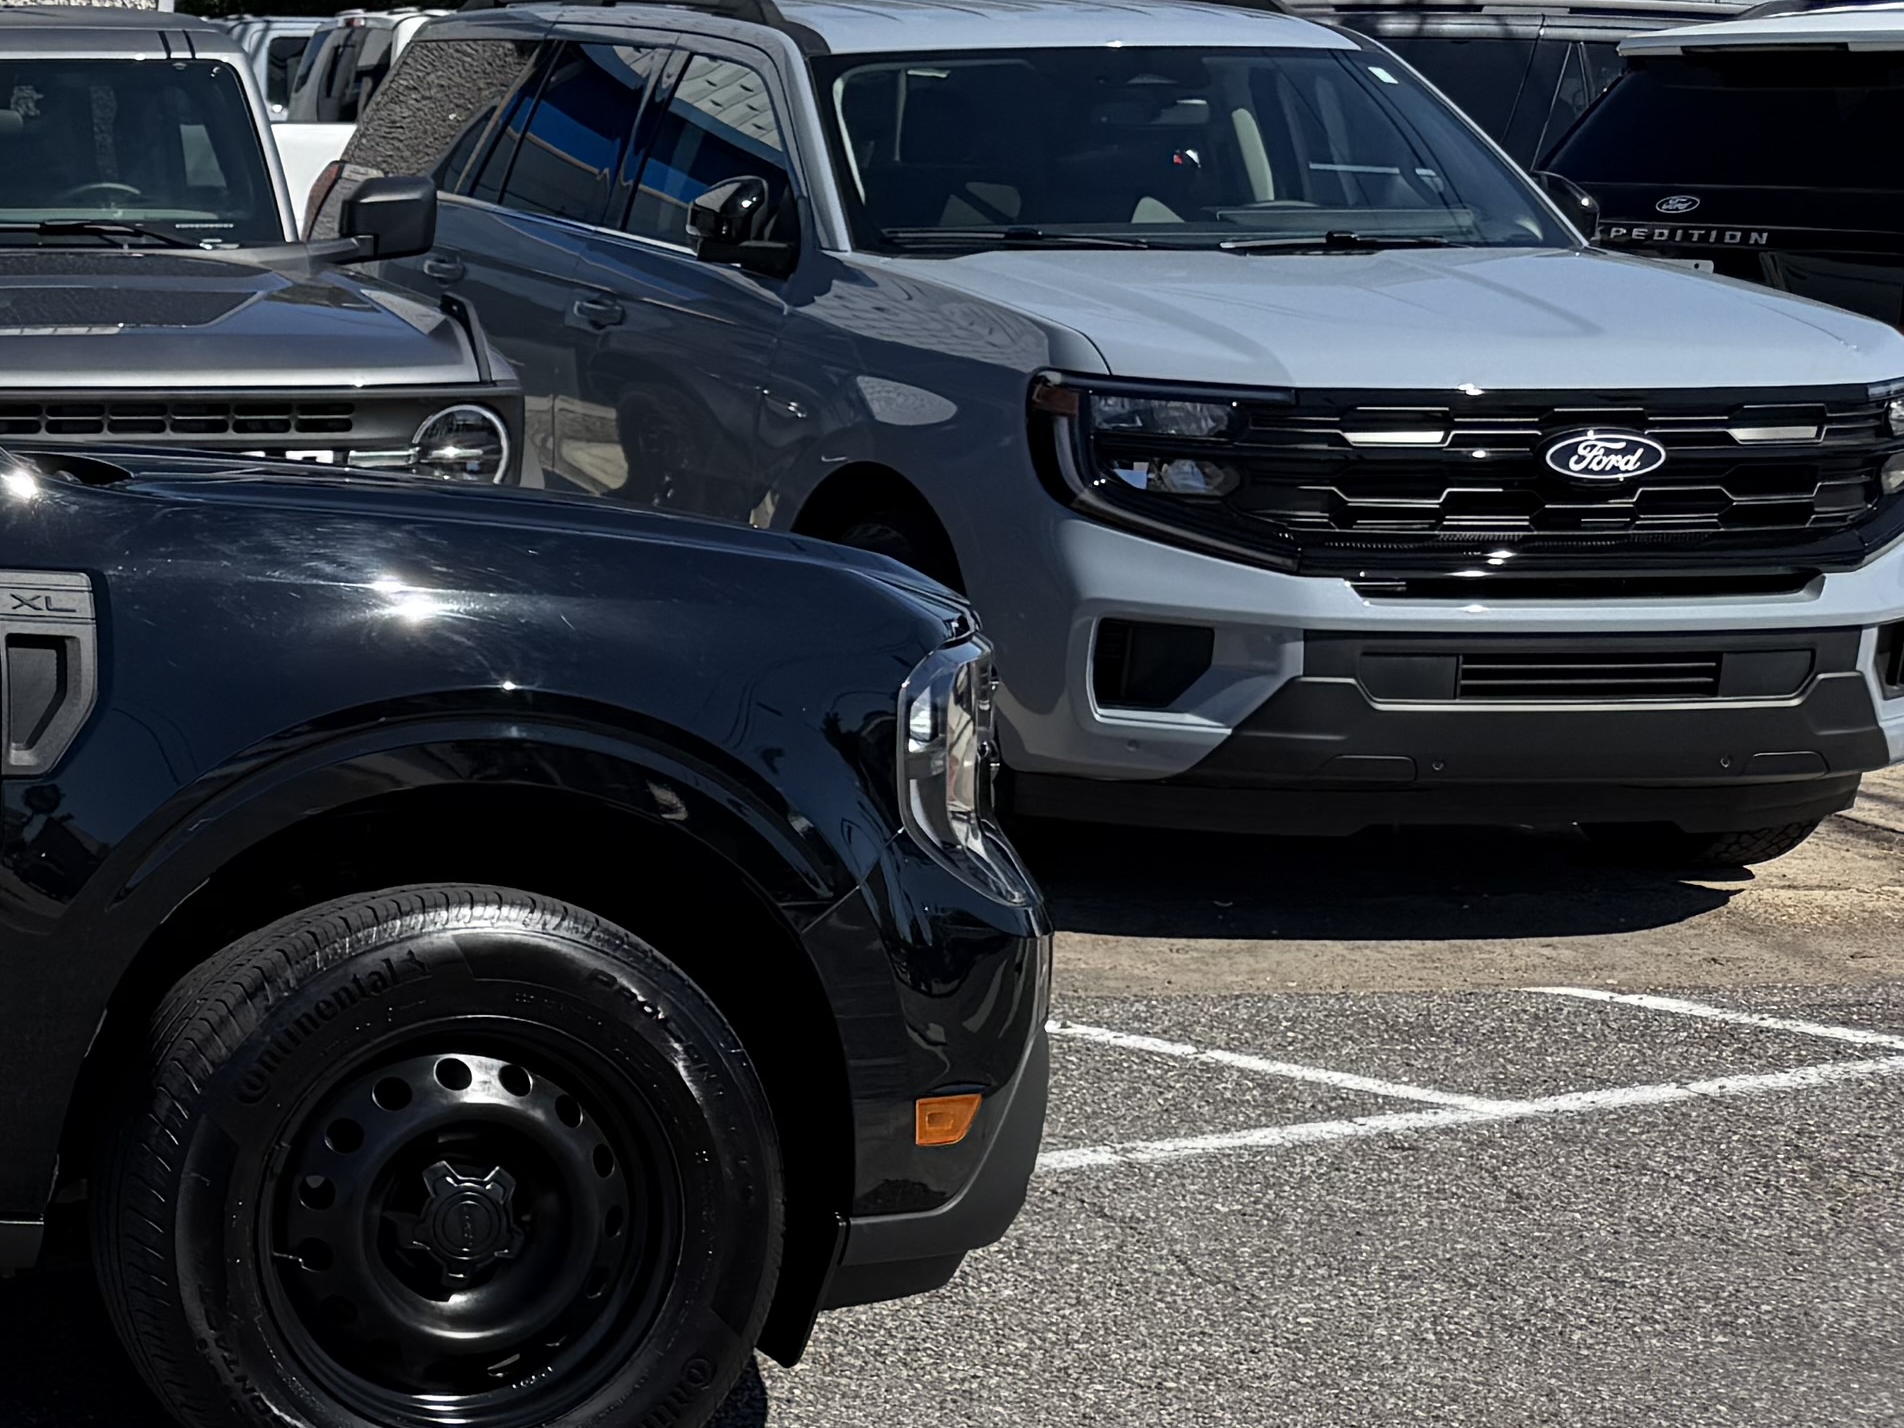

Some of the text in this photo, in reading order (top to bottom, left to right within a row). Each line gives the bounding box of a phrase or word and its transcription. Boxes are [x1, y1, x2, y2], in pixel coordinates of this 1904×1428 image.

[1661, 196, 1693, 211] Ford
[1568, 440, 1644, 471] Ford
[10, 593, 77, 612] XL
[237, 955, 403, 1105] Continental
